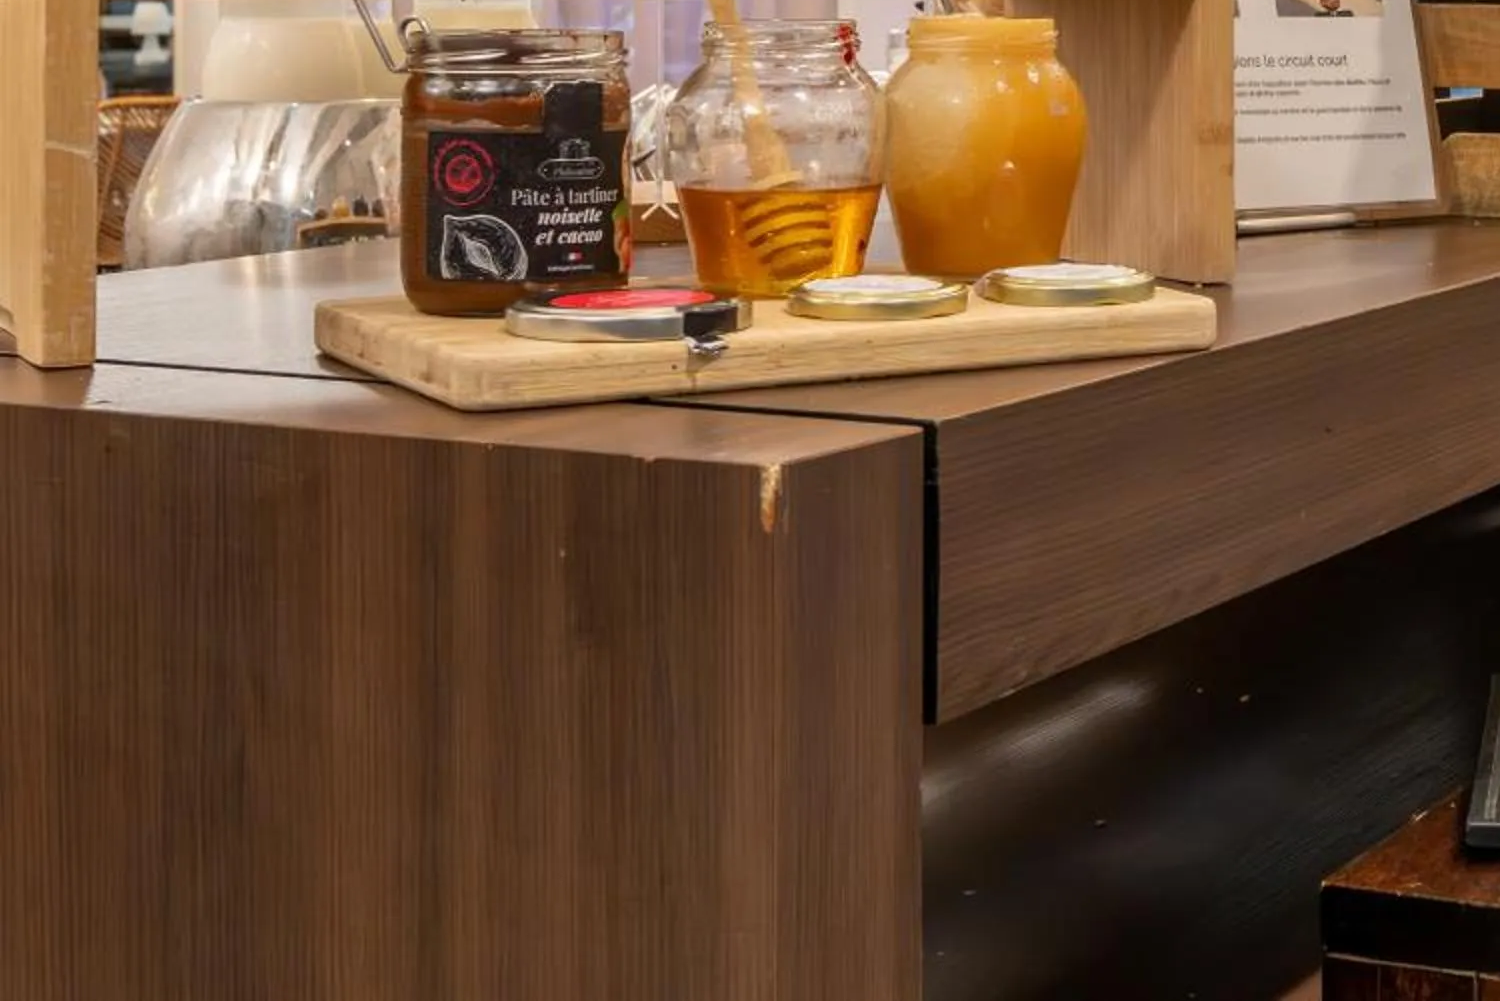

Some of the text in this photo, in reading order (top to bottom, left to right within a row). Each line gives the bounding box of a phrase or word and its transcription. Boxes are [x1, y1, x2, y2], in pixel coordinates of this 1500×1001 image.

[1263, 54, 1275, 68] le
[1278, 54, 1315, 68] circuit
[1318, 54, 1348, 68] court
[511, 185, 620, 207] Pâte à tartiner
[537, 206, 604, 226] noisette
[535, 229, 604, 246] et cacao
